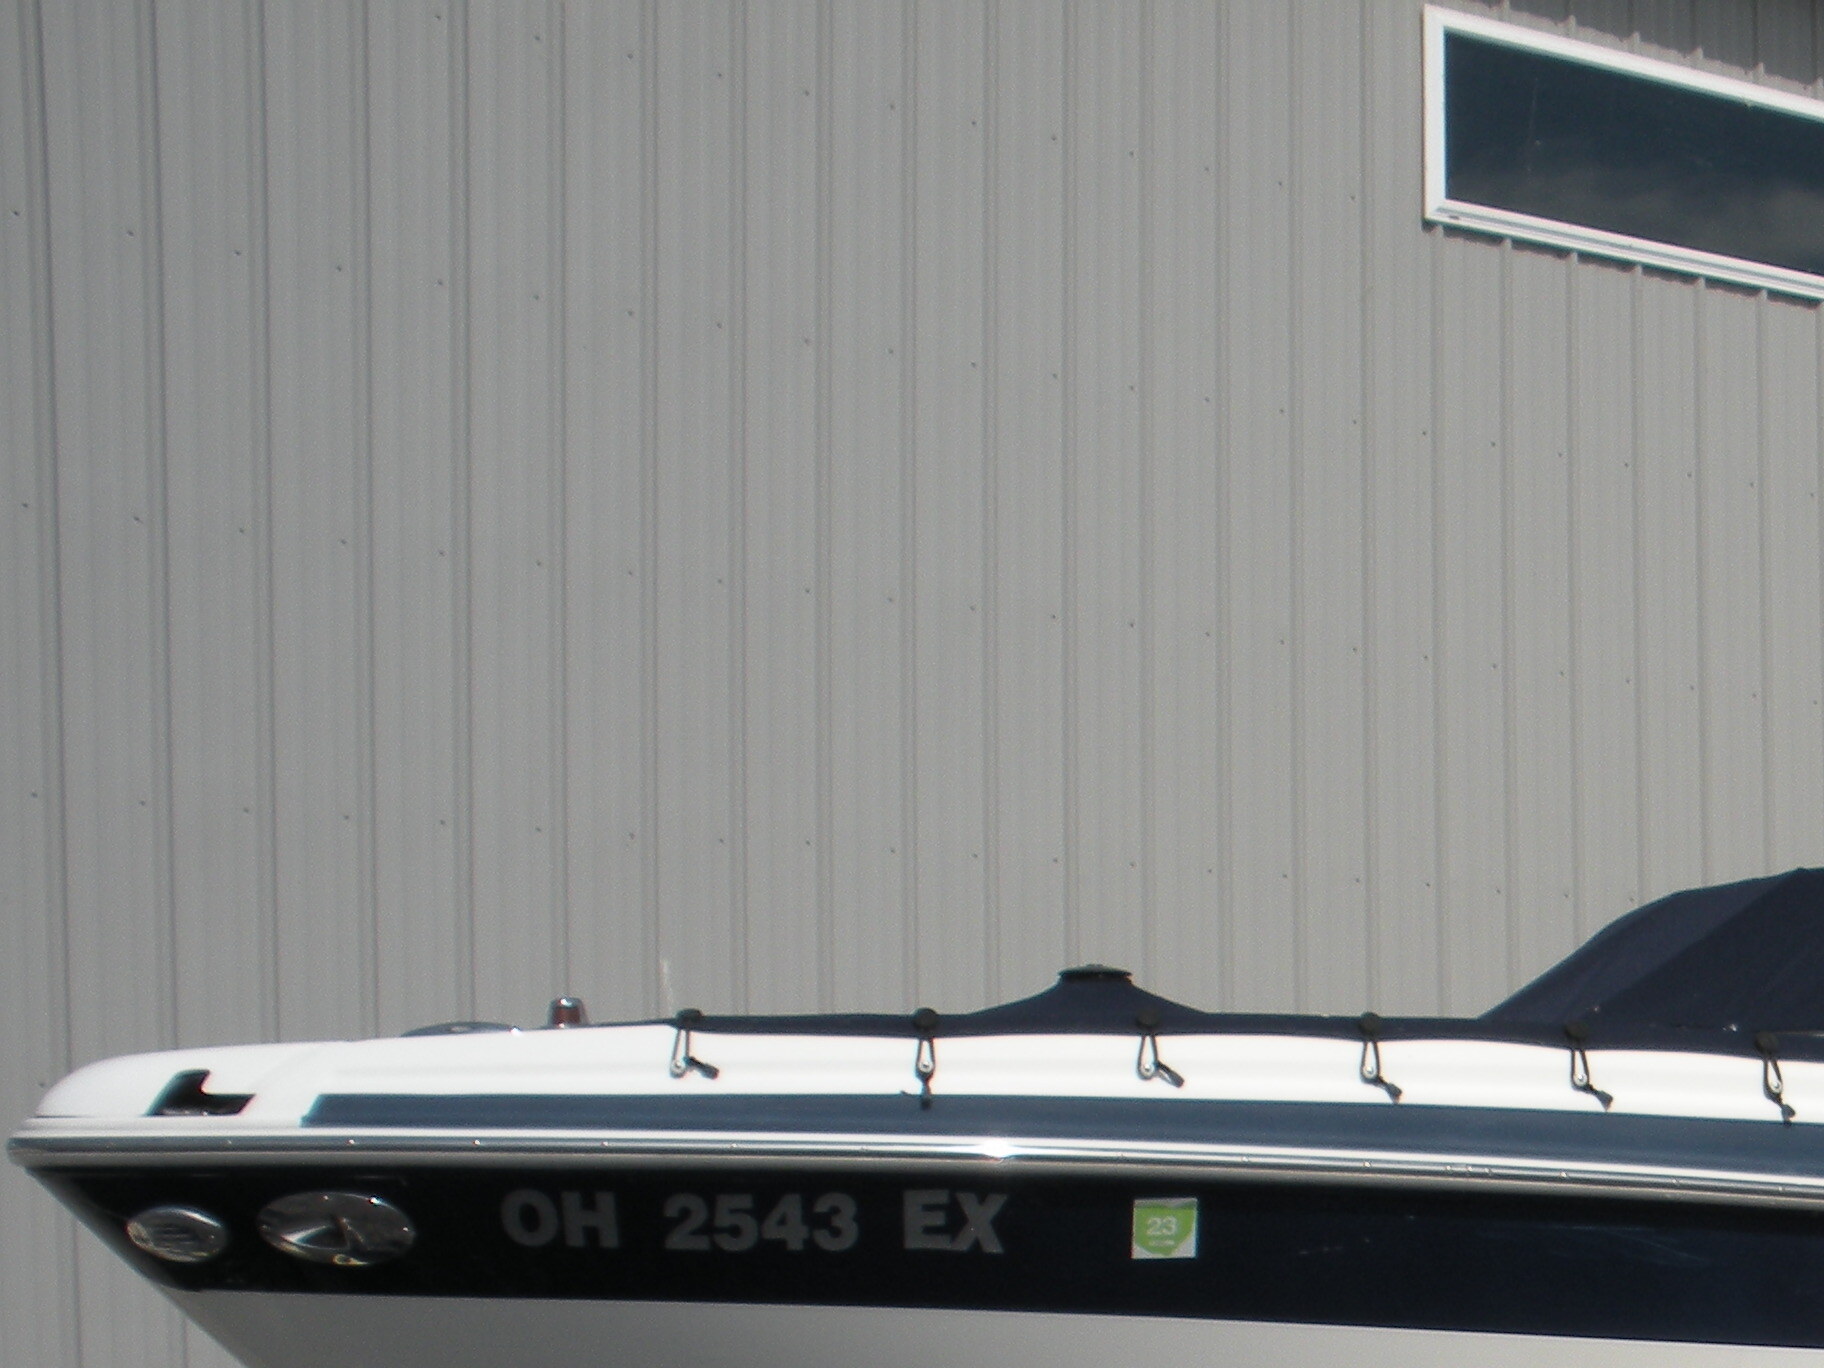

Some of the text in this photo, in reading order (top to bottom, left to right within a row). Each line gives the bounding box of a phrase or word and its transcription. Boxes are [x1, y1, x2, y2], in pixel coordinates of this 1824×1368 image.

[501, 1189, 1008, 1254] OH 2543 EX
